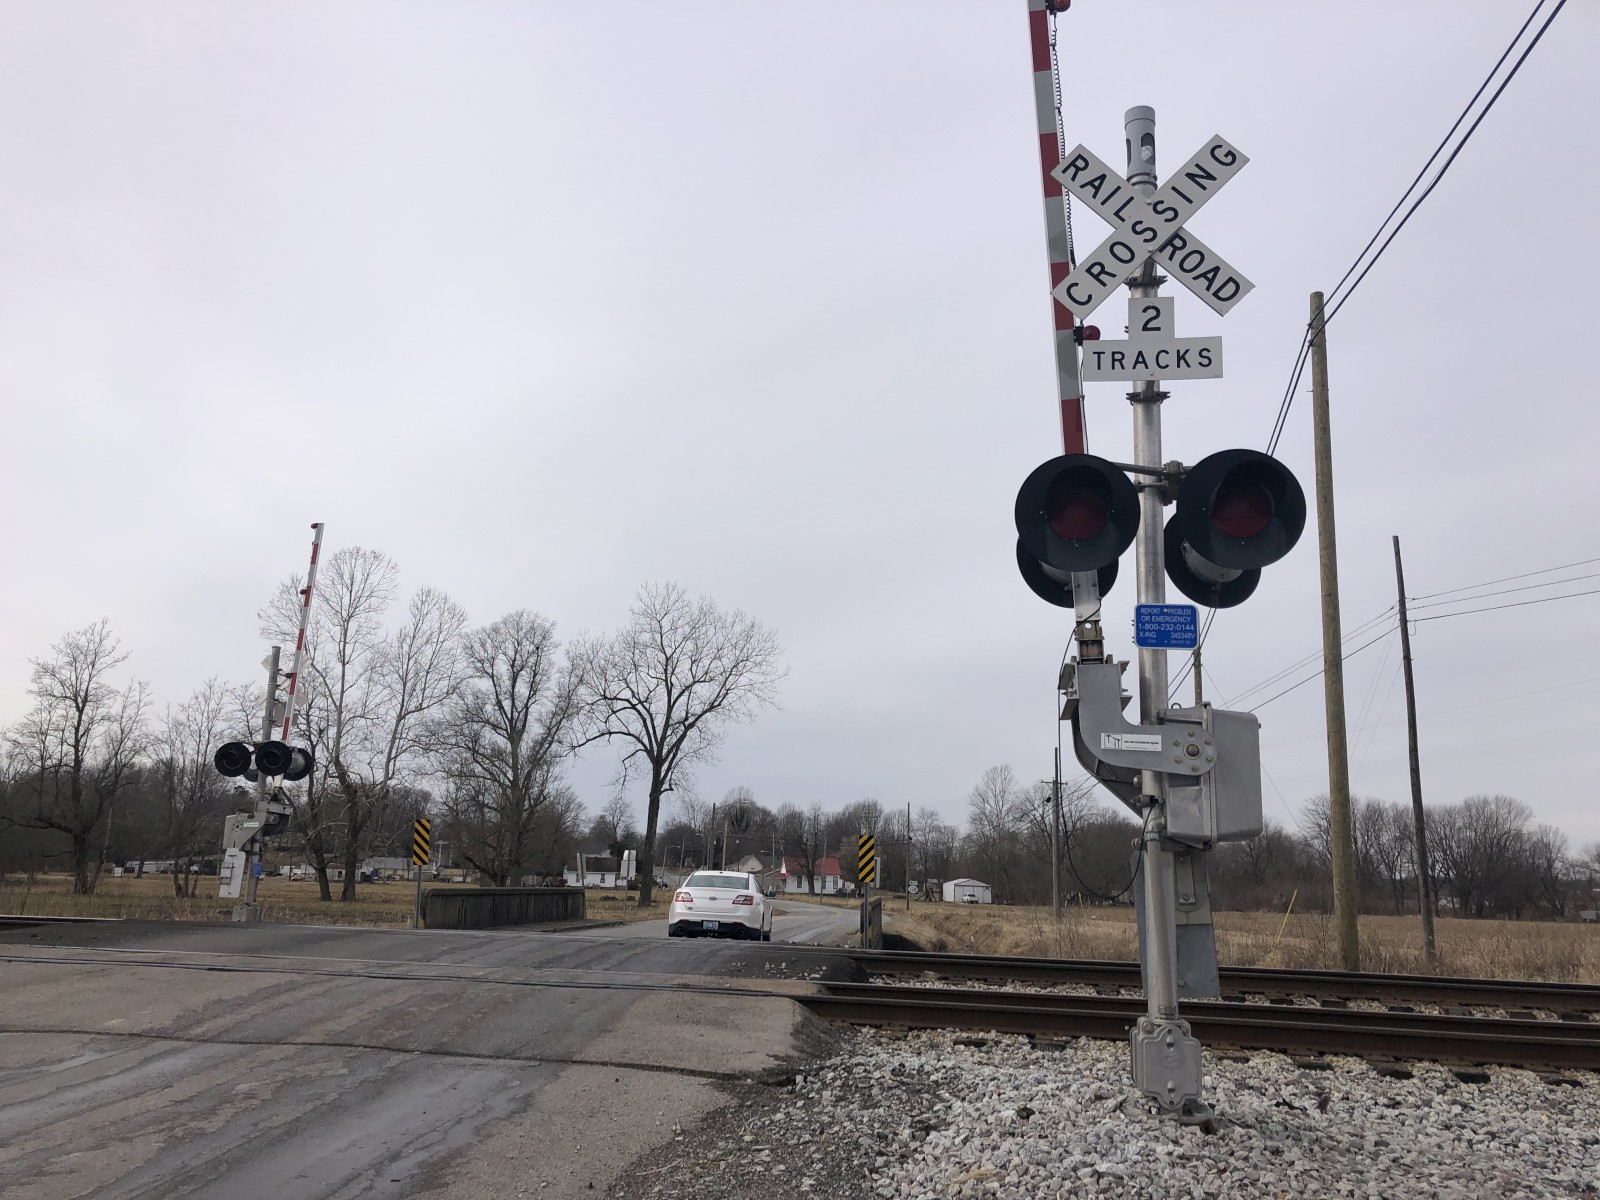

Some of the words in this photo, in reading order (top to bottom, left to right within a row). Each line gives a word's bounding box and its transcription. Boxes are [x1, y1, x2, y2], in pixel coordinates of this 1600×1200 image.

[1066, 144, 1237, 306] CROSSING
[1141, 305, 1162, 332] 2
[1092, 347, 1213, 371] TRACKS
